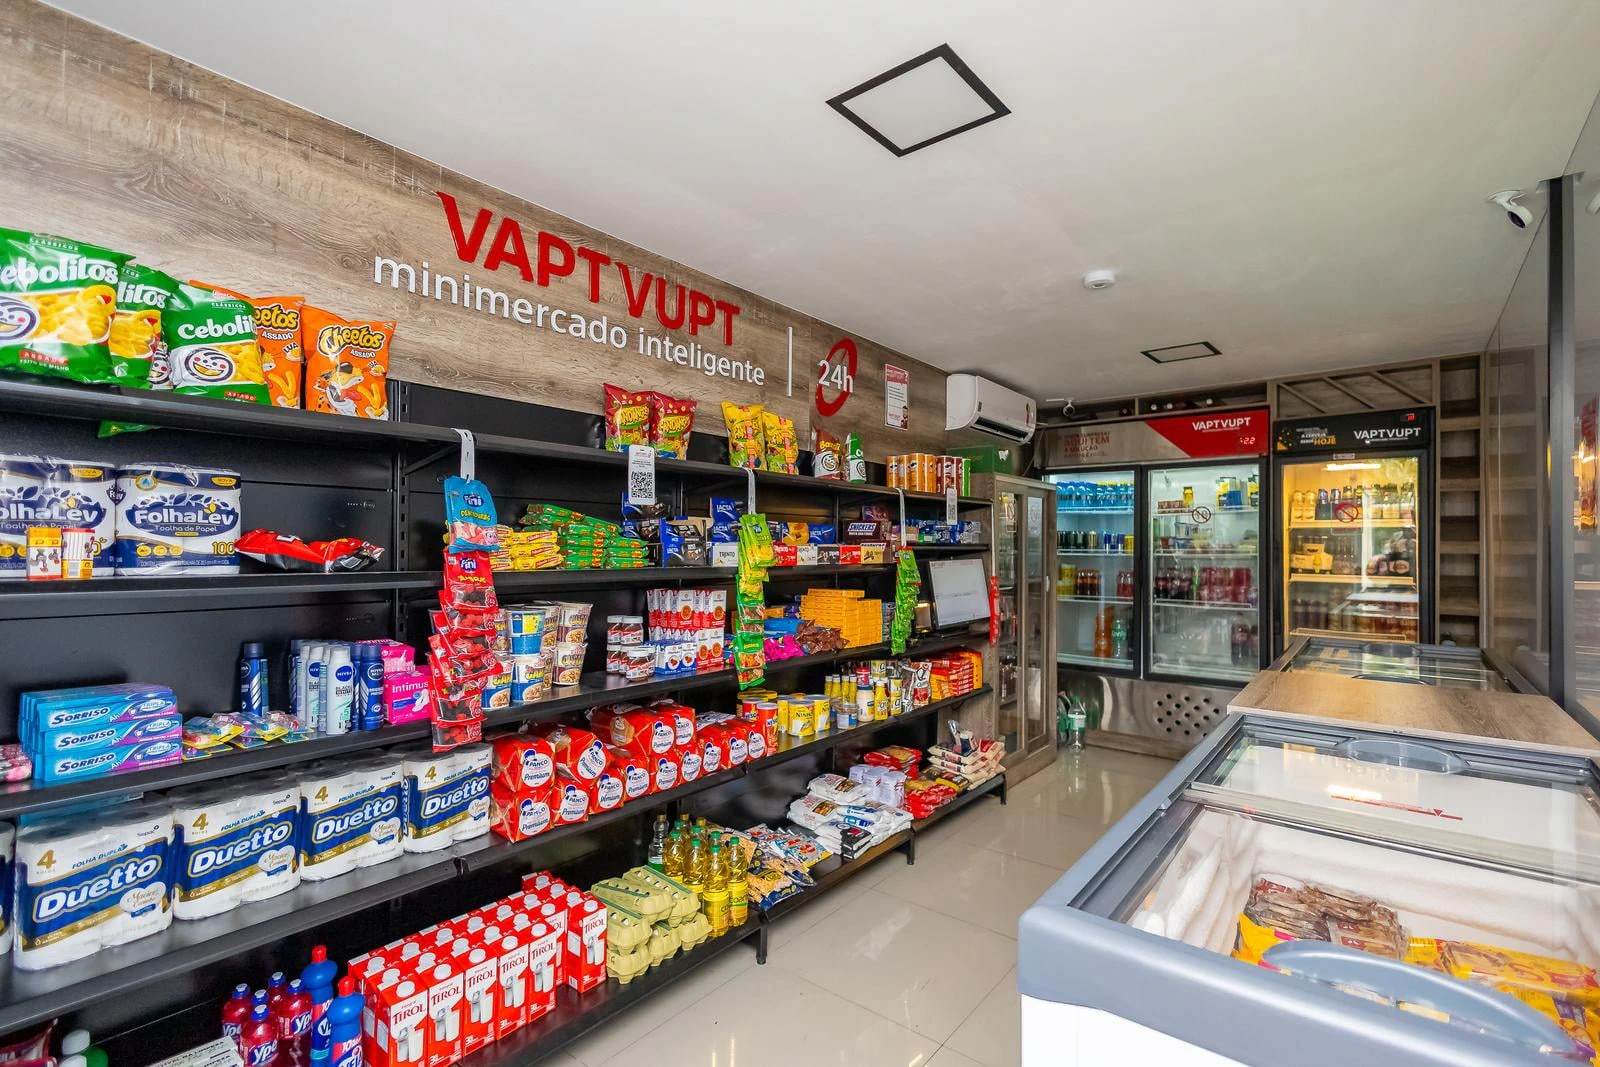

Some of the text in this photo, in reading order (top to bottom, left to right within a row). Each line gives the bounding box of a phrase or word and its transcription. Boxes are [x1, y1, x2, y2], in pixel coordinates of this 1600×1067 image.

[0, 256, 118, 286] ebolitos
[117, 281, 171, 309] litos
[254, 304, 300, 330] eetos
[374, 256, 766, 386] minimercado inteligente
[261, 330, 294, 341] ASSADO
[319, 326, 385, 357] Cheetos
[817, 360, 853, 393] 24h
[1312, 436, 1337, 446] HOJE
[0, 503, 99, 524] olhaLev
[134, 508, 235, 526] FolhaLev
[460, 558, 478, 569] Fini
[392, 681, 429, 697] Intimus
[51, 706, 110, 725] SORRISO
[57, 729, 116, 748] SORRISO
[57, 752, 116, 774] SORRISO
[528, 759, 549, 768] PANCO
[425, 766, 437, 780] 4
[524, 772, 550, 781] Premium
[315, 785, 328, 802] 4
[423, 777, 489, 817] Duetto
[191, 813, 209, 830] 4
[315, 797, 397, 842] Duetto
[37, 849, 57, 869] 4
[191, 824, 291, 875] Duetto
[72, 856, 97, 870] FOLHA
[37, 858, 159, 920] Duetto
[583, 919, 605, 935] TIROL
[531, 943, 556, 961] TIROL
[500, 956, 528, 975] TIROL
[466, 970, 496, 989] TIROL
[430, 986, 462, 1007] TIROL
[391, 1004, 427, 1026] TIROL
